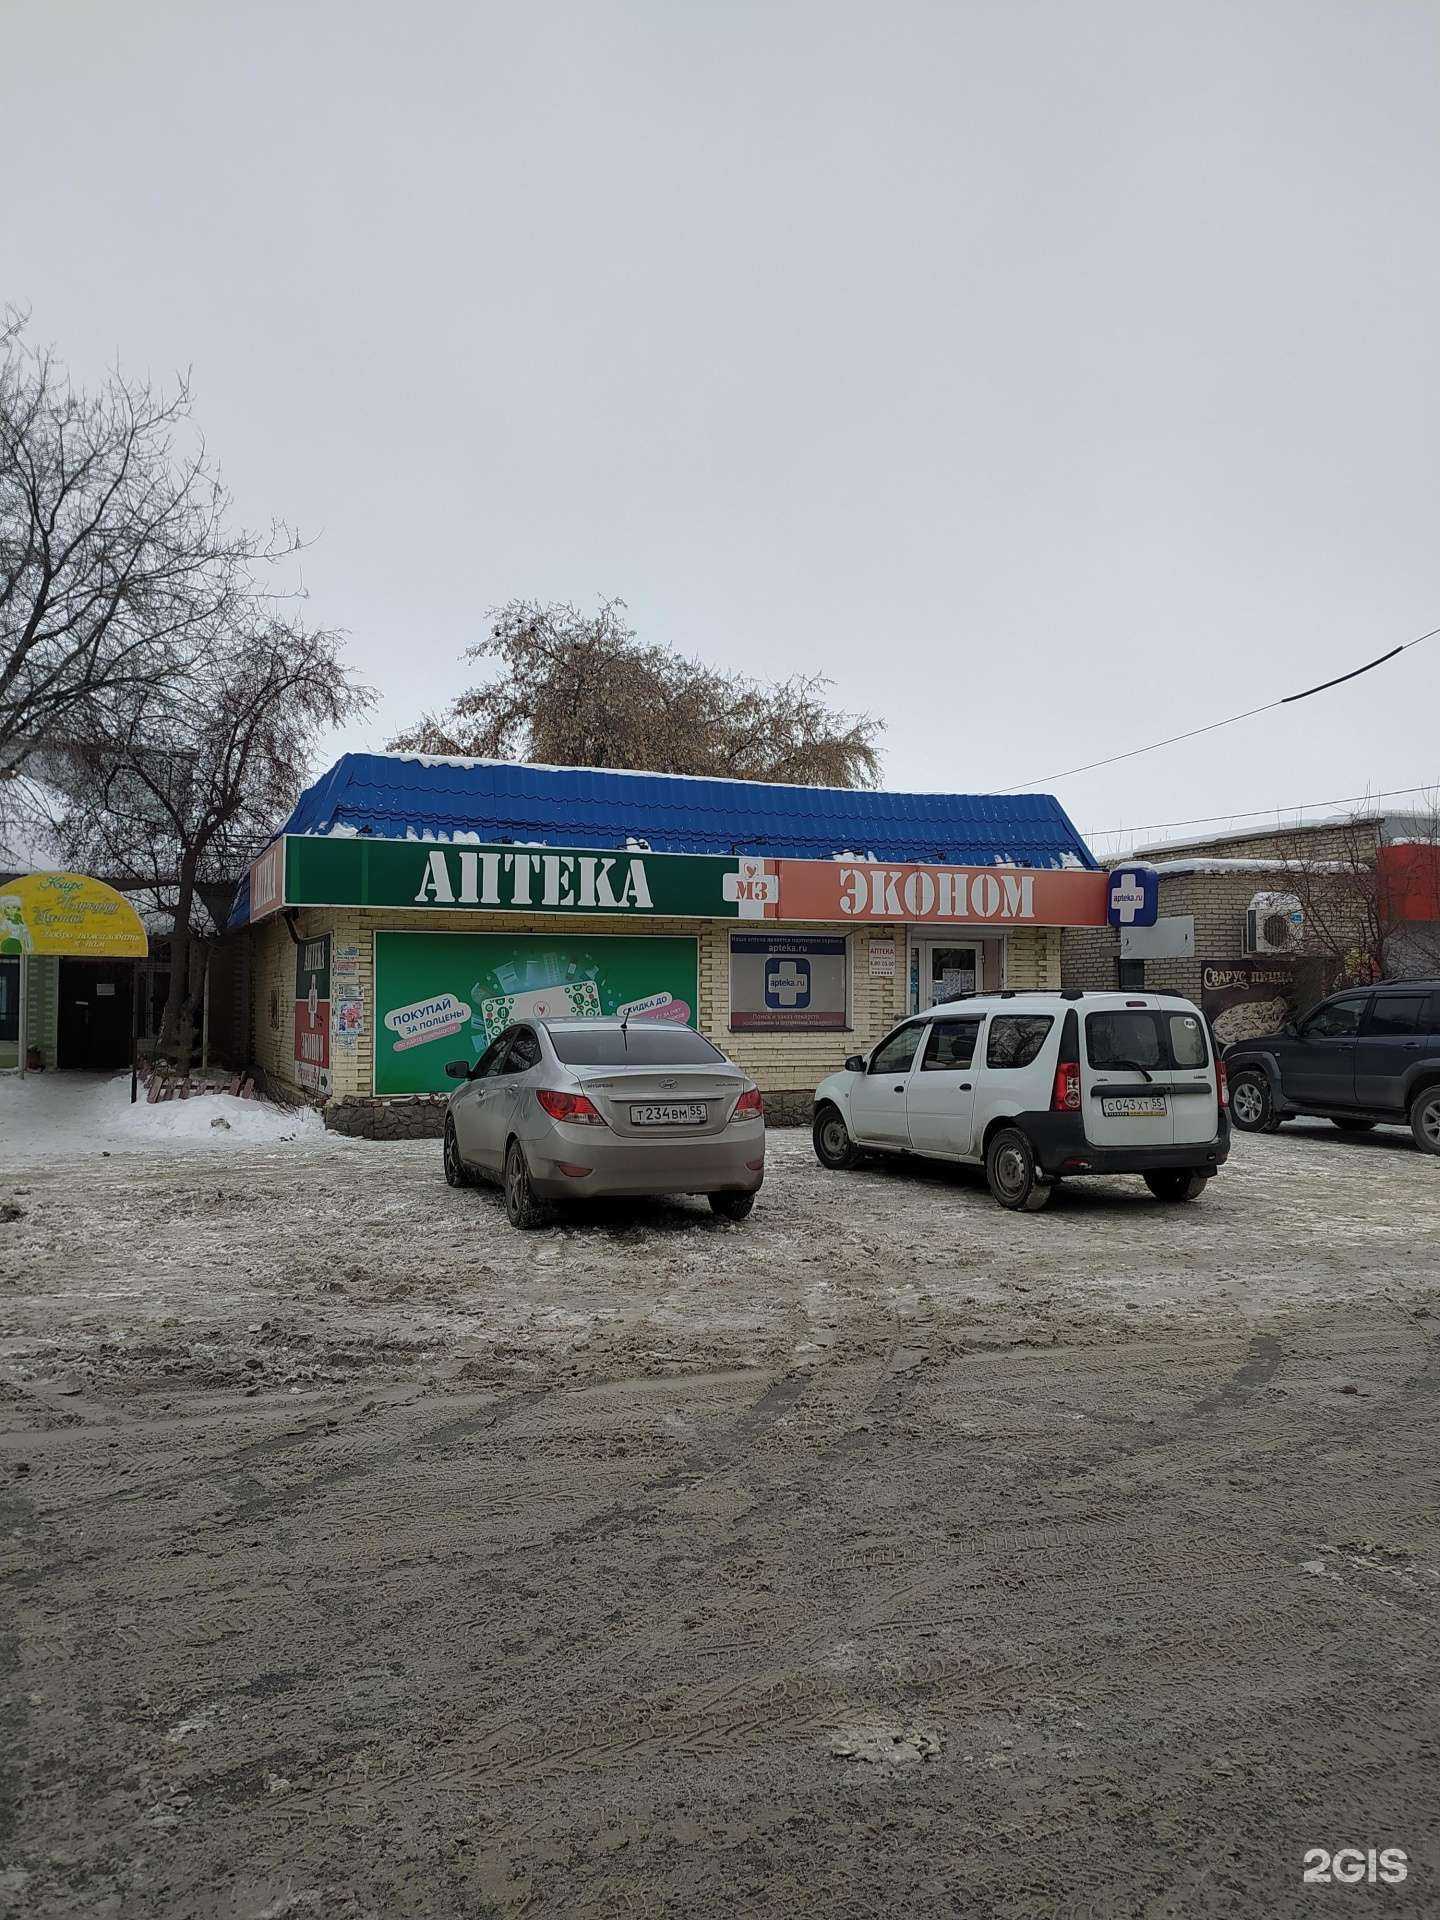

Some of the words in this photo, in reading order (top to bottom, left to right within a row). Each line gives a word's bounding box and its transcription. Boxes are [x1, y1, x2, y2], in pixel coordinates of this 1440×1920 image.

[415, 850, 653, 908] АПТЕКА
[838, 867, 1036, 919] ЭКОНОМ
[1113, 892, 1143, 903] apteka.ru
[768, 944, 808, 954] apteka.ru
[769, 978, 805, 988] apteka.ru
[656, 996, 668, 1006] ДО
[393, 997, 452, 1027] ПОКУПАЙ
[406, 1025, 418, 1035] ЗА
[419, 1009, 465, 1030] ПОЛЦЕНЫ
